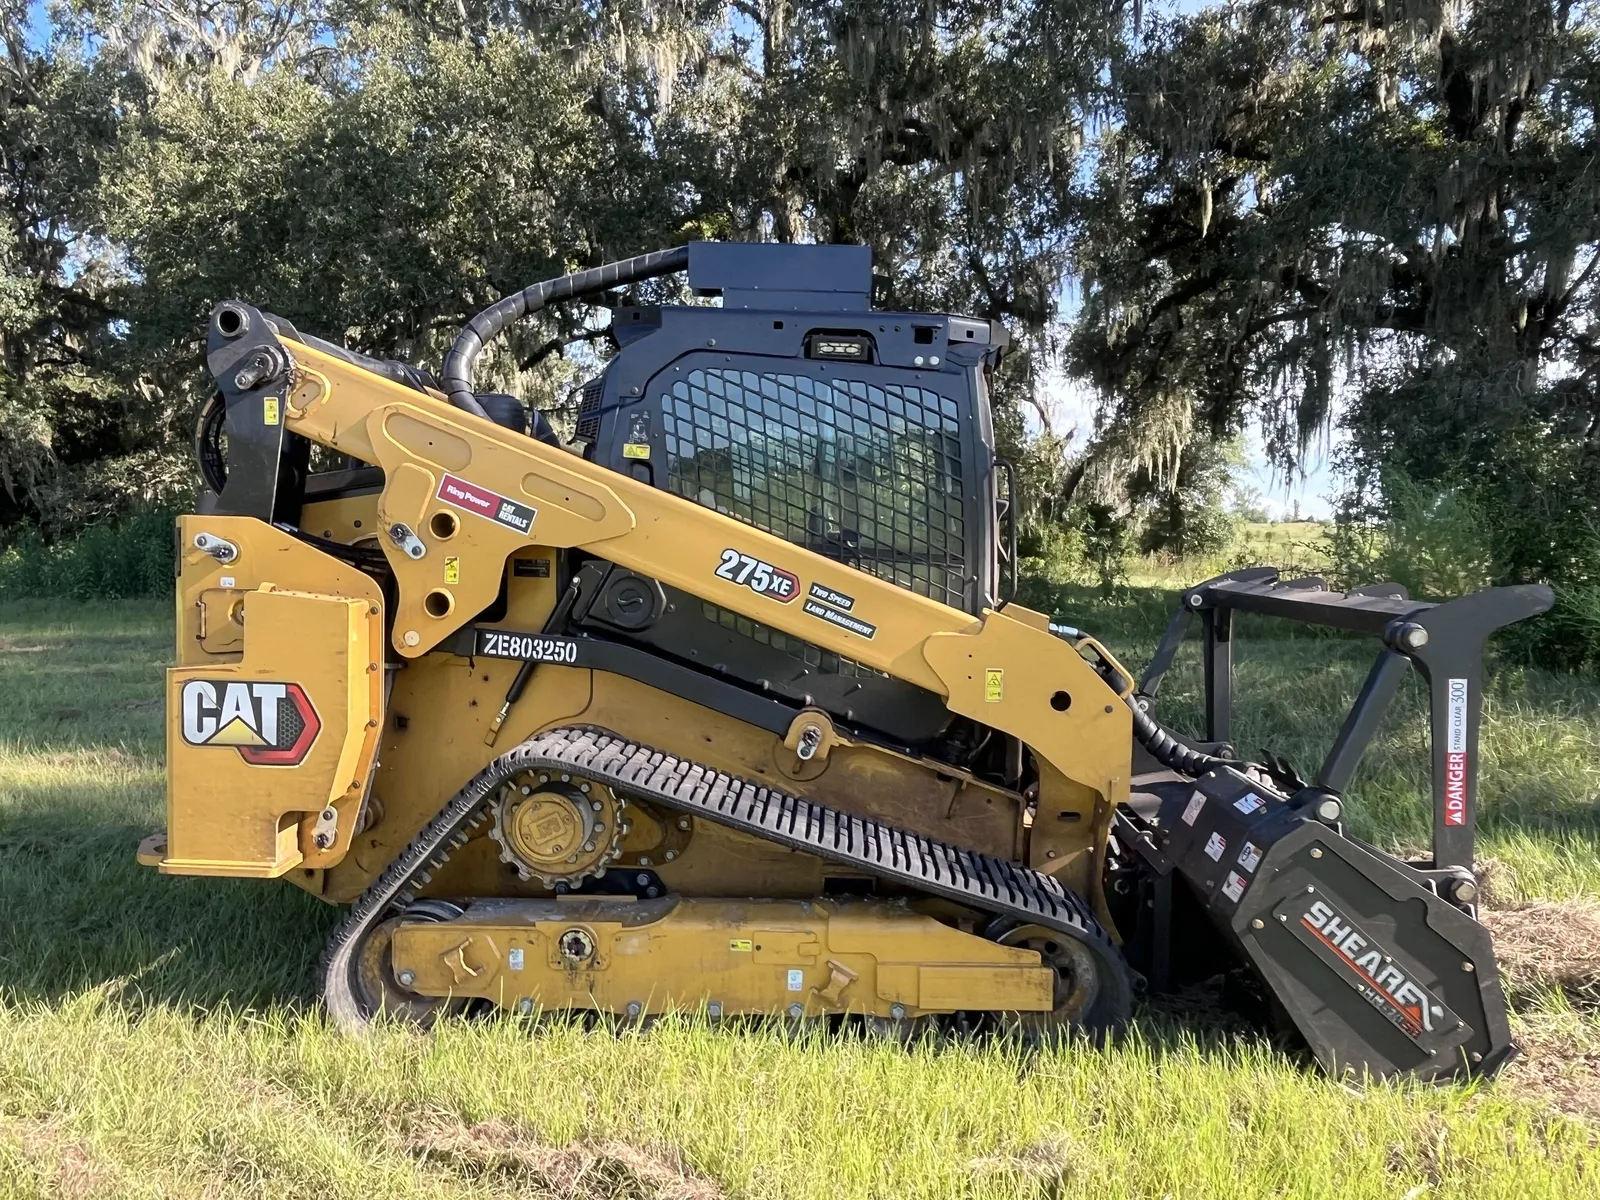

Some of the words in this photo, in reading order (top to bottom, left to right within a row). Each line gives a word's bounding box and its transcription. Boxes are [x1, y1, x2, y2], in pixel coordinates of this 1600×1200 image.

[446, 484, 465, 499] Ring
[464, 491, 491, 508] Power
[498, 511, 528, 529] RENTALS
[501, 502, 516, 515] CAT
[483, 633, 577, 663] ZE803250
[183, 680, 287, 746] CAT
[1453, 706, 1462, 727] CLEAR
[1453, 728, 1462, 751] STAND
[1447, 753, 1464, 811] DANGER
